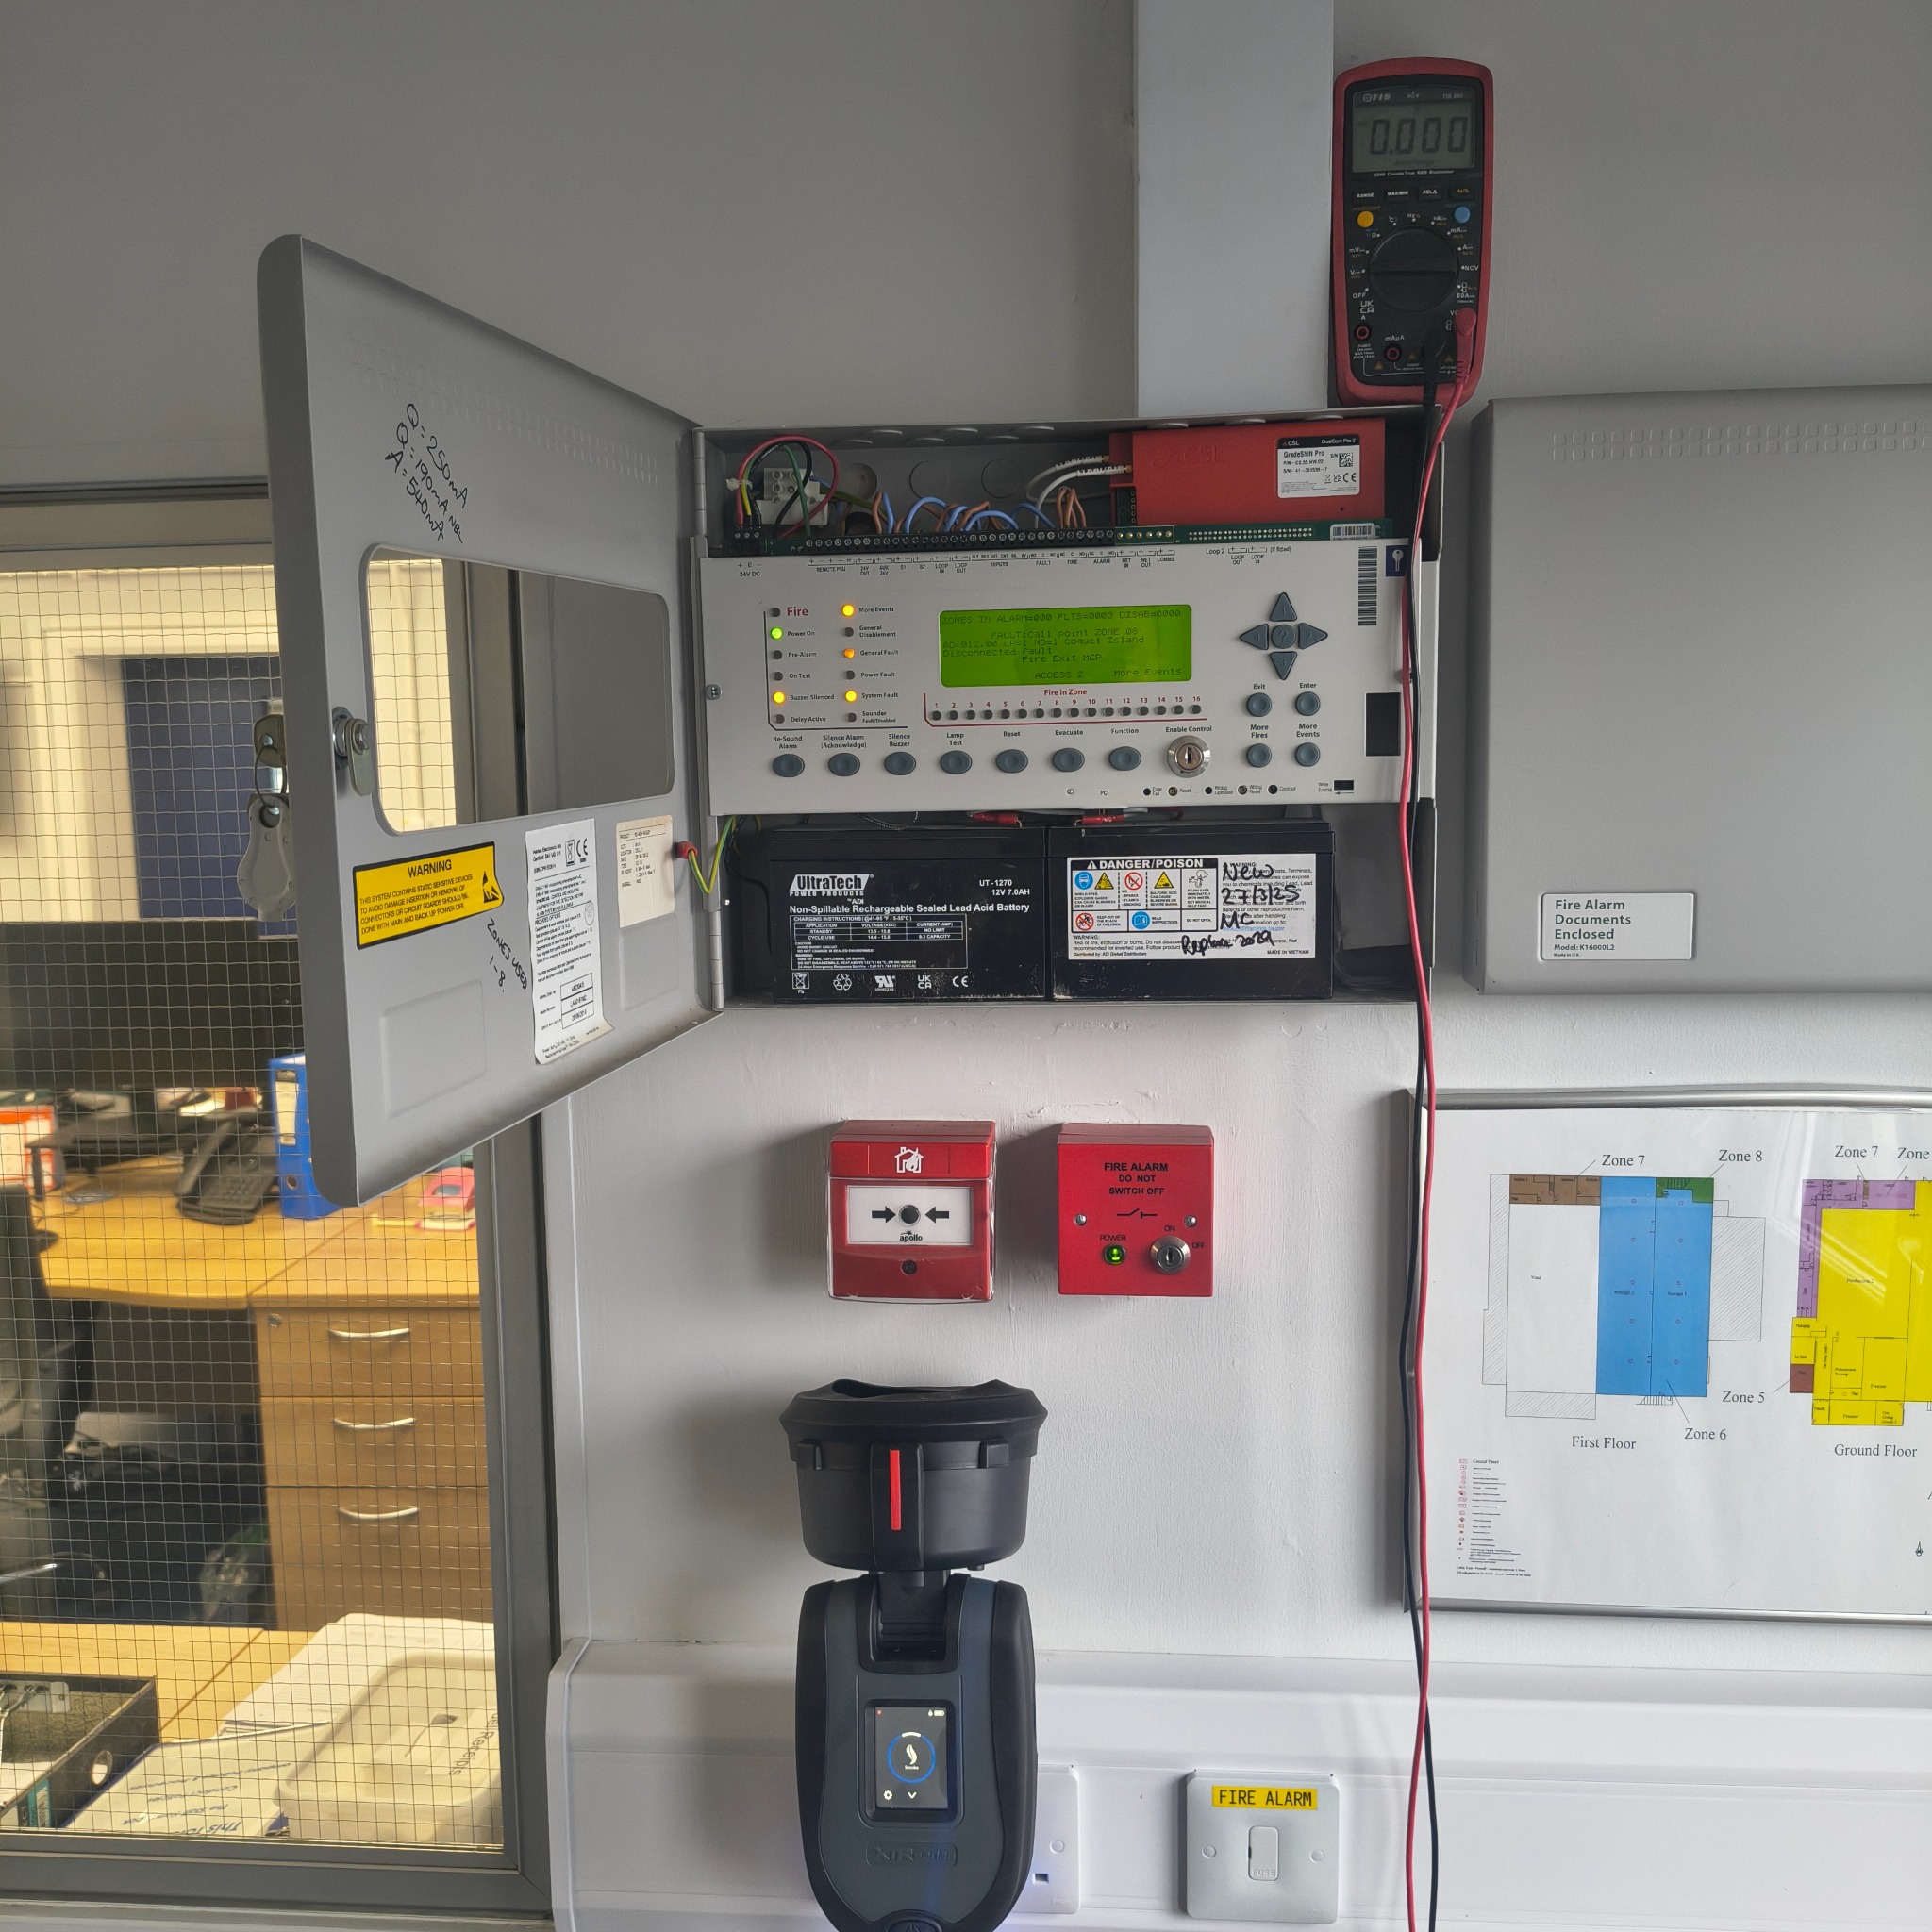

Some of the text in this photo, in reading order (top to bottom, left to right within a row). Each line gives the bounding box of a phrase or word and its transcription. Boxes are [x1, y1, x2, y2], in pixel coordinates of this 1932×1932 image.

[1370, 116, 1468, 154] 0.000
[787, 607, 808, 616] Fire
[408, 859, 452, 879] WARNING
[1099, 859, 1203, 869] DANGER/POISON
[1223, 862, 1274, 881] New
[797, 875, 862, 889] UltraTech
[373, 892, 391, 903] SYSTEM
[392, 888, 416, 898] CONTAINS
[417, 884, 432, 894] STATIC
[433, 879, 454, 890] SENSITIVE
[455, 874, 473, 884] DEVICES
[368, 903, 383, 913] AVOID
[384, 898, 405, 910] DAMAGE
[406, 892, 430, 905] INSERTION
[438, 886, 457, 897] REMOVAL
[1221, 885, 1300, 905] 27/3/25
[361, 911, 395, 924] CONNECTORS
[404, 904, 422, 915] CIRCUIT
[423, 900, 442, 910] BOARDS
[442, 895, 461, 906] SHOULD
[790, 903, 1030, 914] Non-Spillable Rechargeable Sealed Lead Acid Battery
[1555, 899, 1625, 910] Fire Alarm
[361, 924, 376, 934] DONE
[377, 921, 389, 931] WITH
[390, 918, 403, 927] MAIN
[403, 915, 414, 924] AND
[415, 912, 429, 921] BACK
[437, 906, 455, 917] POWER
[1220, 911, 1253, 929] MC
[1555, 914, 1631, 925] Documents
[1555, 929, 1614, 939] Enclosed
[486, 917, 527, 990] ZONES USED
[1719, 1150, 1763, 1162] Zone 8
[1835, 1146, 1878, 1157] Zone 7
[1897, 1148, 1930, 1159] Zone
[1602, 1155, 1645, 1167] Zone 7
[1104, 1163, 1168, 1172] FIRE ALARM
[899, 1234, 923, 1243] apollo
[1722, 1391, 1765, 1403] Zone 5
[1684, 1428, 1726, 1440] Zone 6
[1571, 1436, 1637, 1449] First Floor
[1834, 1444, 1917, 1457] Ground Floor
[1219, 1789, 1312, 1806] FIRE ALARM
